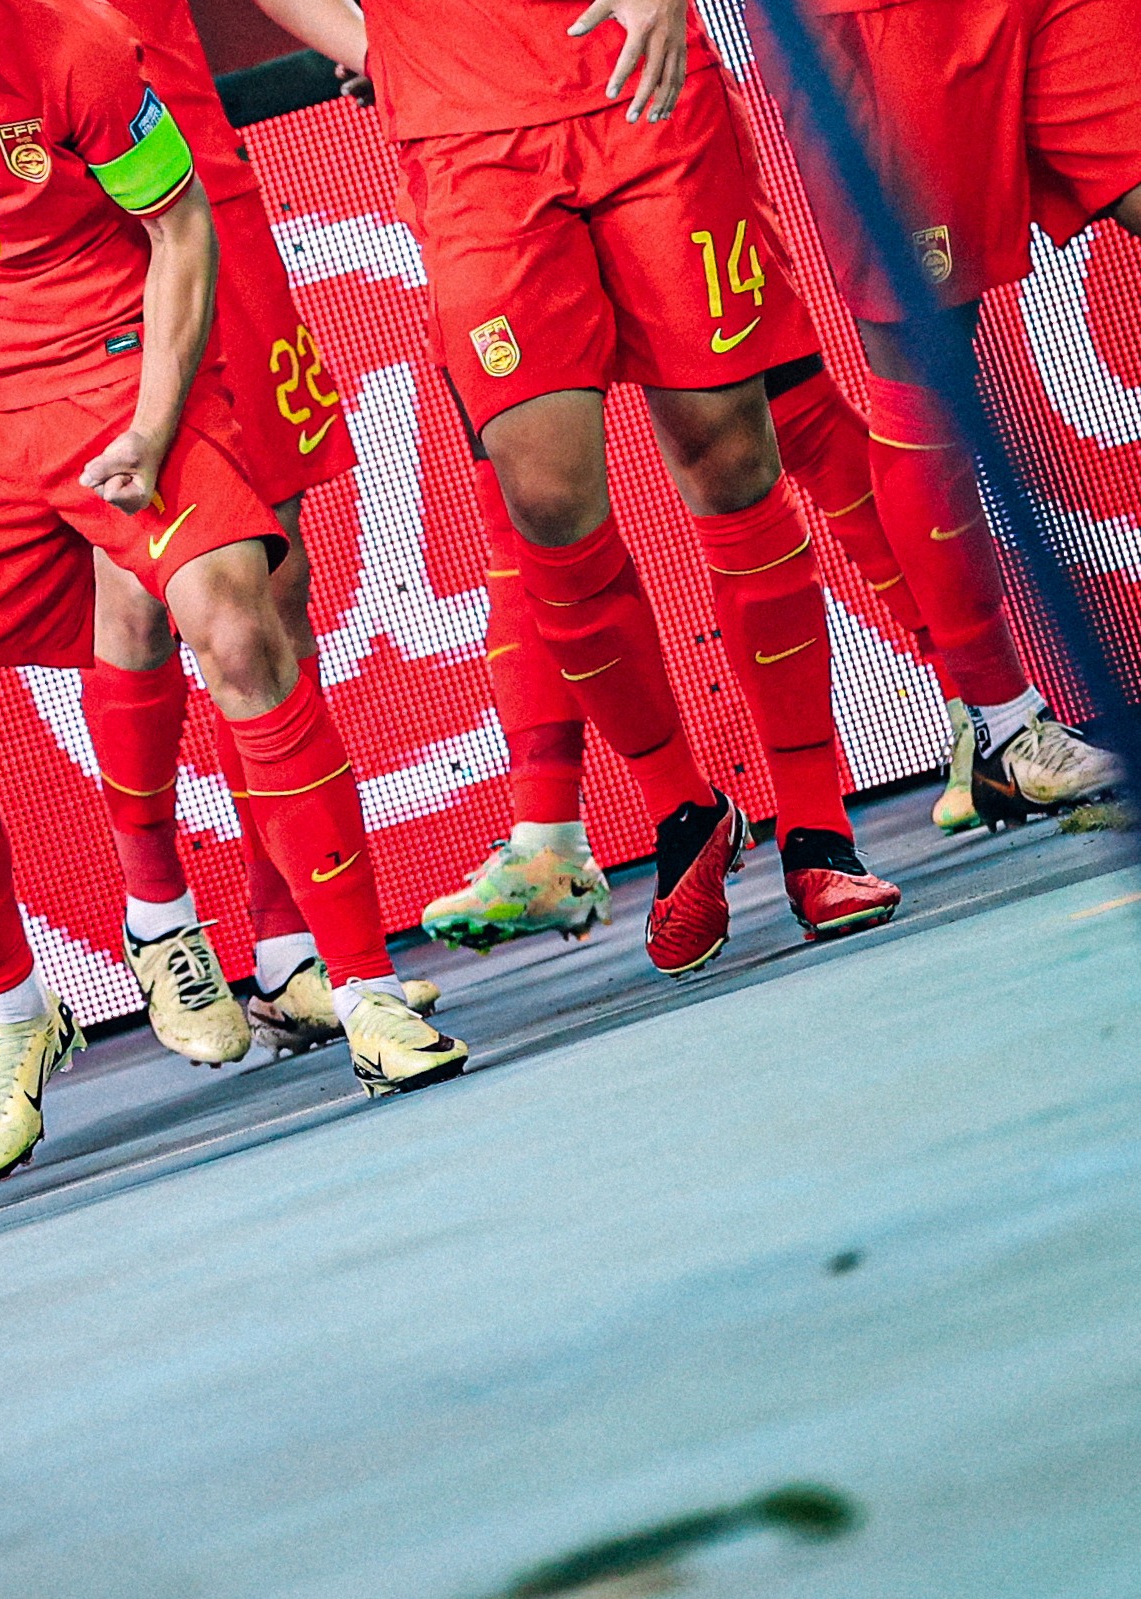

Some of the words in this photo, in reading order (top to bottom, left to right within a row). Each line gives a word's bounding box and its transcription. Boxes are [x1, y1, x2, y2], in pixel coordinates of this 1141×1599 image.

[0, 122, 42, 140] CFA
[691, 219, 765, 318] 14
[269, 325, 339, 425] 22
